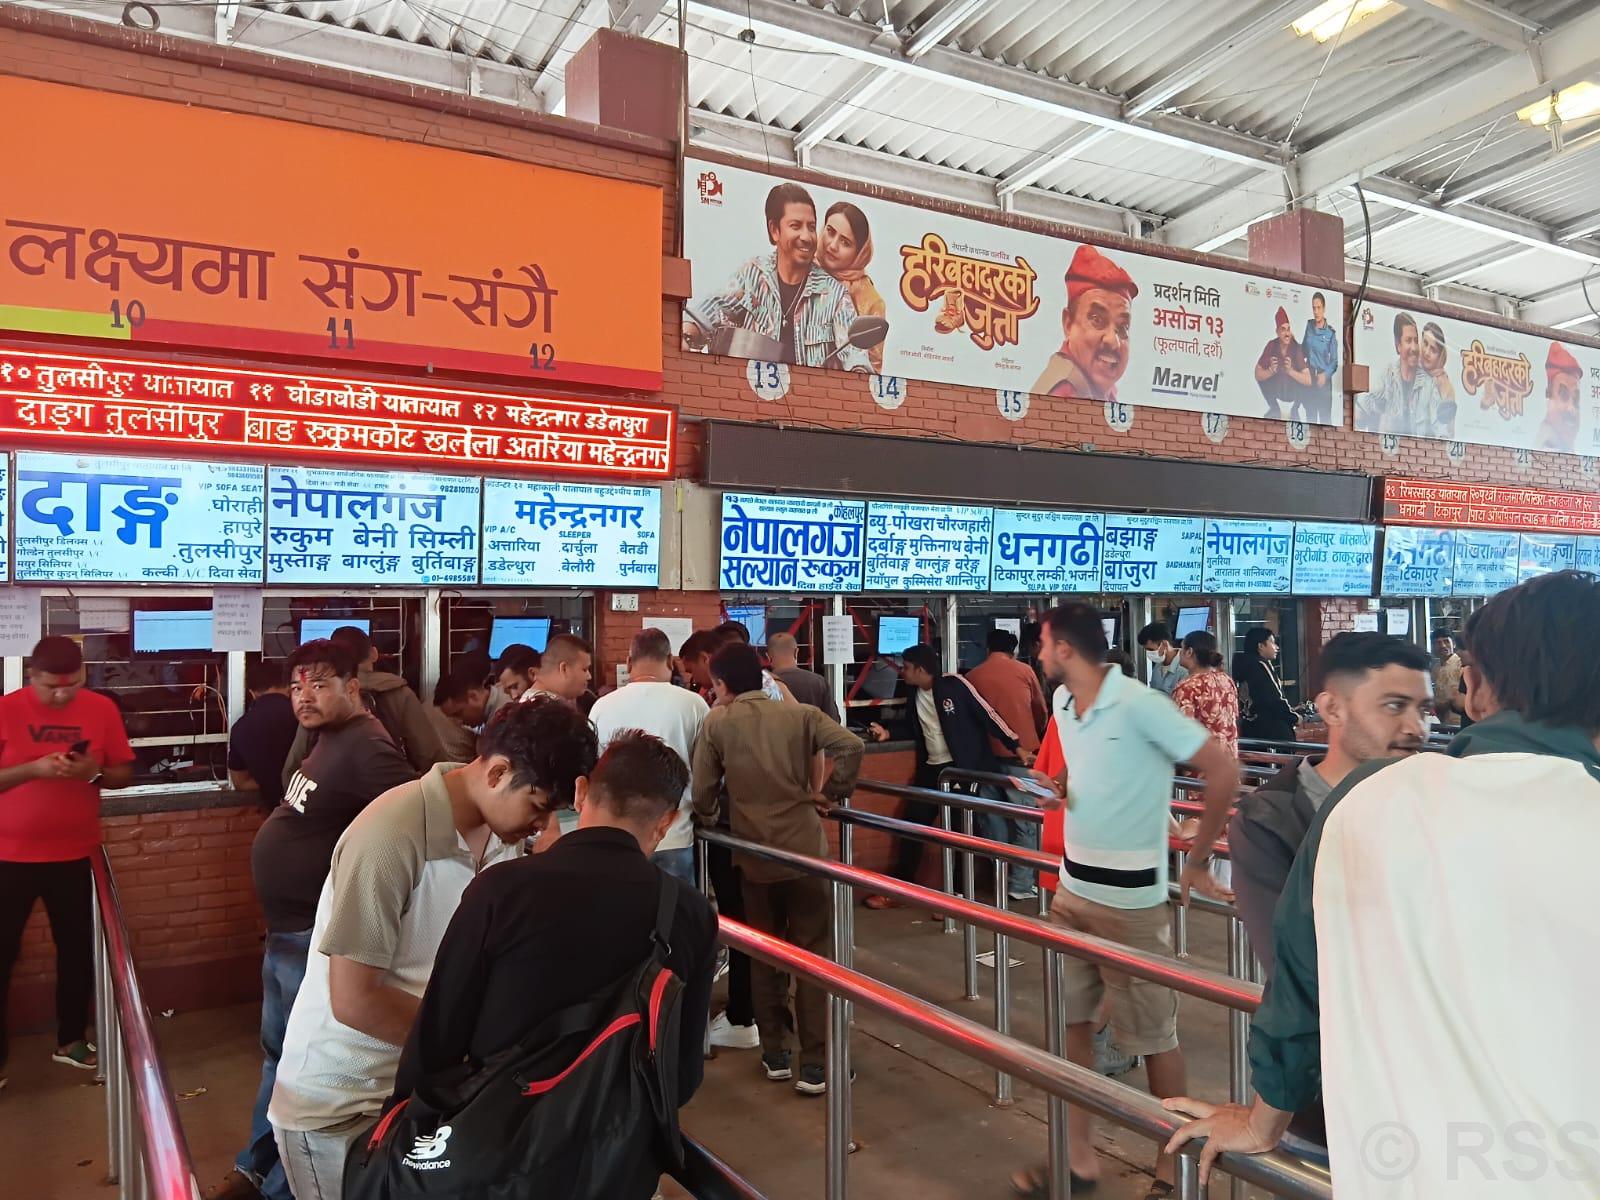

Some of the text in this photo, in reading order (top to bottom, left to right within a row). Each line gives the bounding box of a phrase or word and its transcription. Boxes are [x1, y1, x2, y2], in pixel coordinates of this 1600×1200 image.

[5, 219, 558, 333] लक्ष्यमा संग-संगै
[1153, 282, 1192, 303] प्रदर्शन
[1193, 285, 1220, 308] मिति
[109, 299, 145, 330] 10
[1153, 305, 1223, 338] असोज १३
[326, 317, 355, 350] 11
[530, 342, 557, 371] 12
[1154, 336, 1200, 357] (फूलपाती,
[754, 362, 780, 388] 13
[1152, 366, 1219, 392] Marvel
[878, 375, 898, 399] 14
[0, 363, 31, 382] १०
[35, 362, 135, 397] तुलसीपुर
[142, 374, 234, 399] यातायात
[250, 383, 274, 402] ११
[382, 395, 461, 418] यातायात
[473, 402, 497, 421] १२
[505, 402, 581, 427] महेन्द्रनगर
[585, 409, 648, 437] डडेलधुरा
[1002, 390, 1021, 413] 15
[104, 403, 224, 440] तुलसीपुर
[1110, 402, 1126, 423] 16
[1291, 421, 1303, 441] 18
[1450, 442, 1463, 457] 20
[1518, 449, 1528, 463] 21
[527, 482, 560, 492] महाकाली
[212, 495, 264, 516] घोराही
[514, 492, 644, 530] महेन्द्रनगर
[223, 518, 262, 538] हापुरे
[936, 514, 991, 534] चौरजहारी
[16, 536, 54, 546] तुलसीपुर
[269, 522, 476, 552] रुकुम बेनी सिम्ली
[559, 531, 591, 539] SLEEPER
[637, 531, 655, 539] SOFA
[909, 534, 962, 556] मुक्तिनाथ
[998, 522, 1104, 566] धनगढी
[1207, 523, 1291, 555] नेपालगंज
[1296, 529, 1335, 547] कोहलपुर
[47, 548, 84, 558] तुलसीपुर
[178, 539, 263, 564] तुलसीपुर
[562, 539, 598, 556] दार्चुला
[1190, 546, 1201, 554] A/C
[17, 568, 54, 579] तुलसीपुर
[142, 565, 179, 577] कल्की
[209, 565, 234, 578] दिवा
[238, 566, 262, 578] सेवा
[488, 557, 535, 575] डडेल्धुरा
[722, 556, 799, 588] सल्यान
[1068, 567, 1099, 581] भजनी
[1104, 560, 1157, 587] बाजुरा
[946, 572, 986, 589] शान्तिपुर
